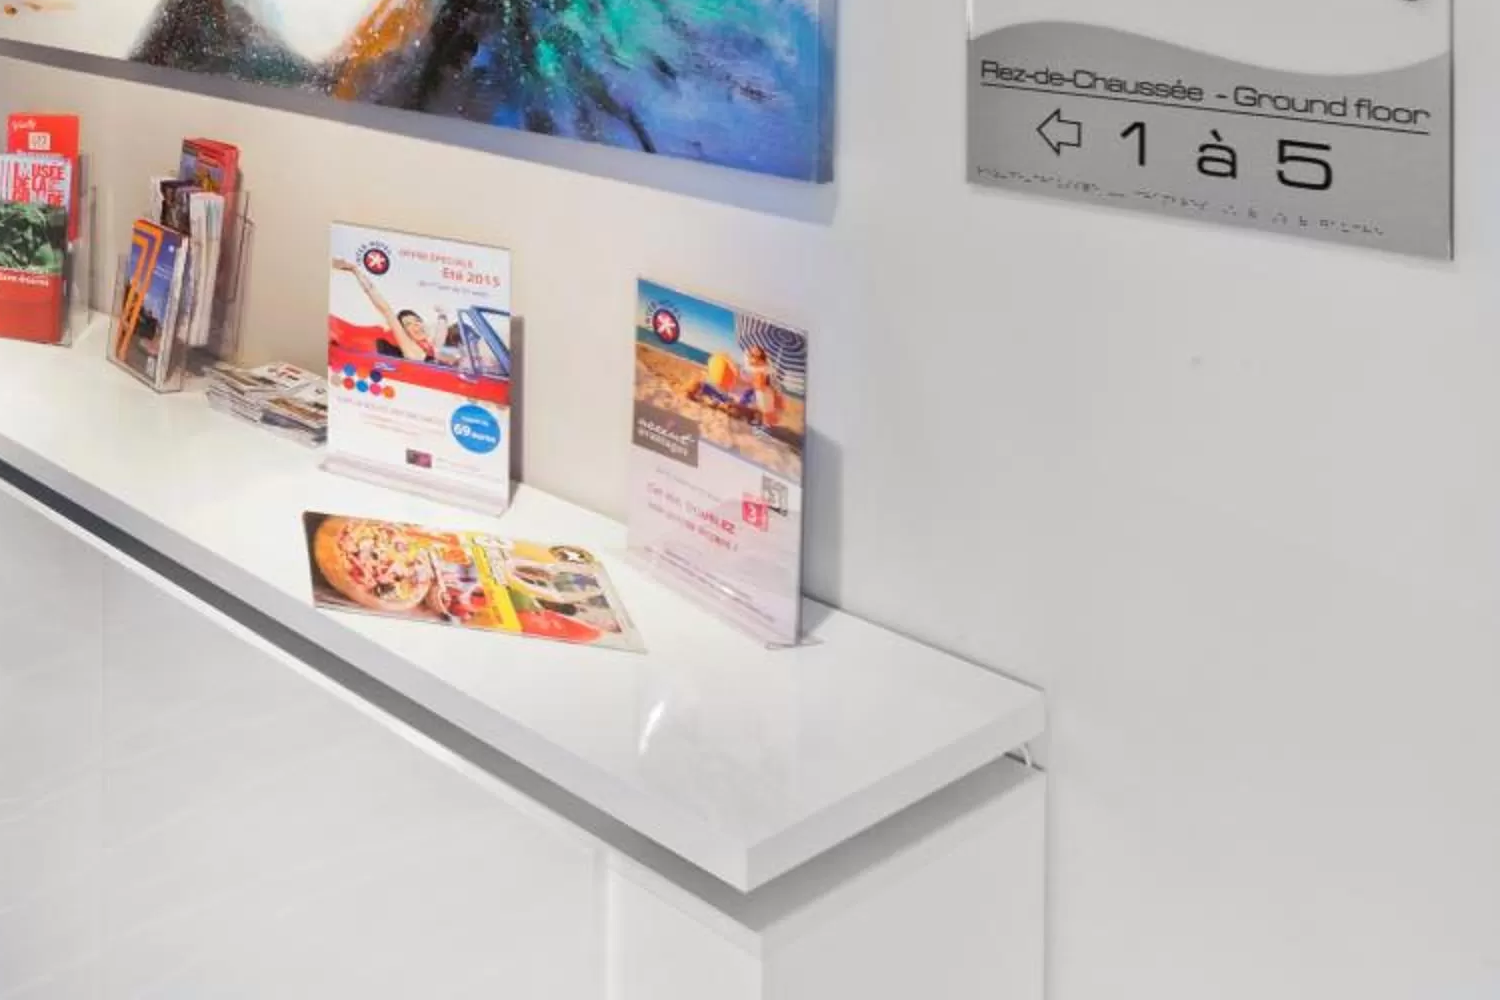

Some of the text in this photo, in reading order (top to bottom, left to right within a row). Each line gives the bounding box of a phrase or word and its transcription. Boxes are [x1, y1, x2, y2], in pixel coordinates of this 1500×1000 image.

[980, 59, 1205, 102] Rez-de-Chaussée
[1234, 86, 1348, 118] Ground
[1355, 98, 1432, 126] floor
[1120, 121, 1334, 192] 1 à 5
[453, 422, 471, 438] 69
